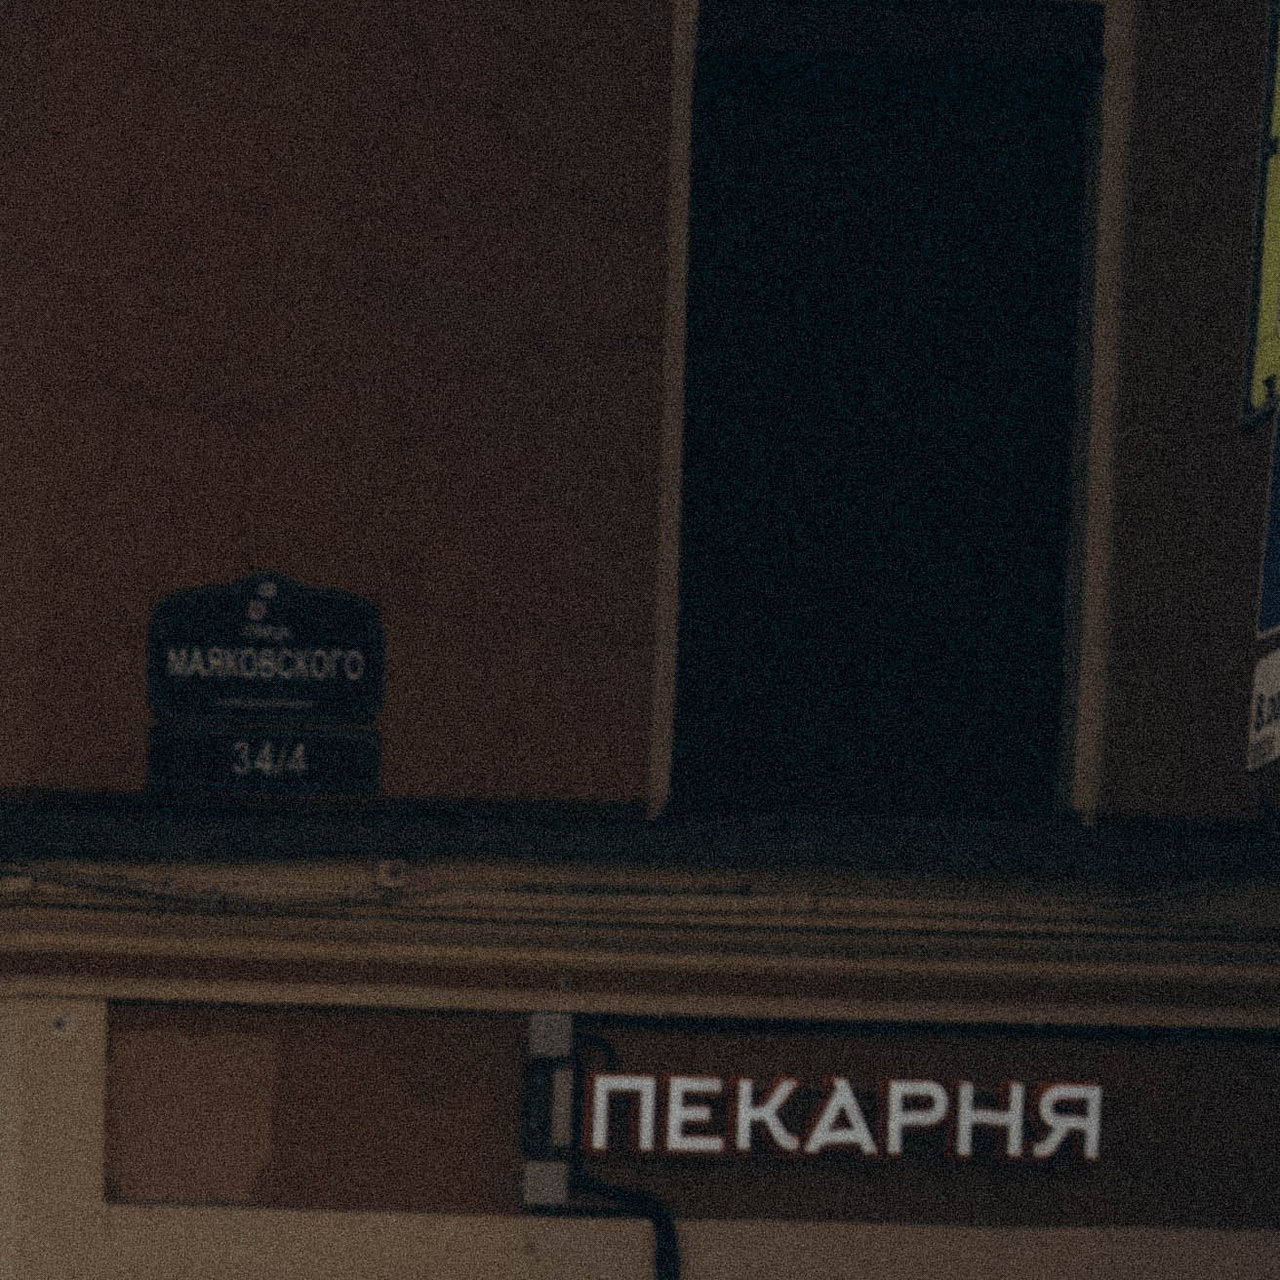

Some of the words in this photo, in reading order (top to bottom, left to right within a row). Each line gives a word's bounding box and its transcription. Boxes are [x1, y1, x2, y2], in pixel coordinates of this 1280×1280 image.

[166, 648, 365, 681] МАЯКОВСКОГО
[232, 741, 308, 775] 34/4
[589, 1073, 1103, 1161] ПЕКАРНЯ
